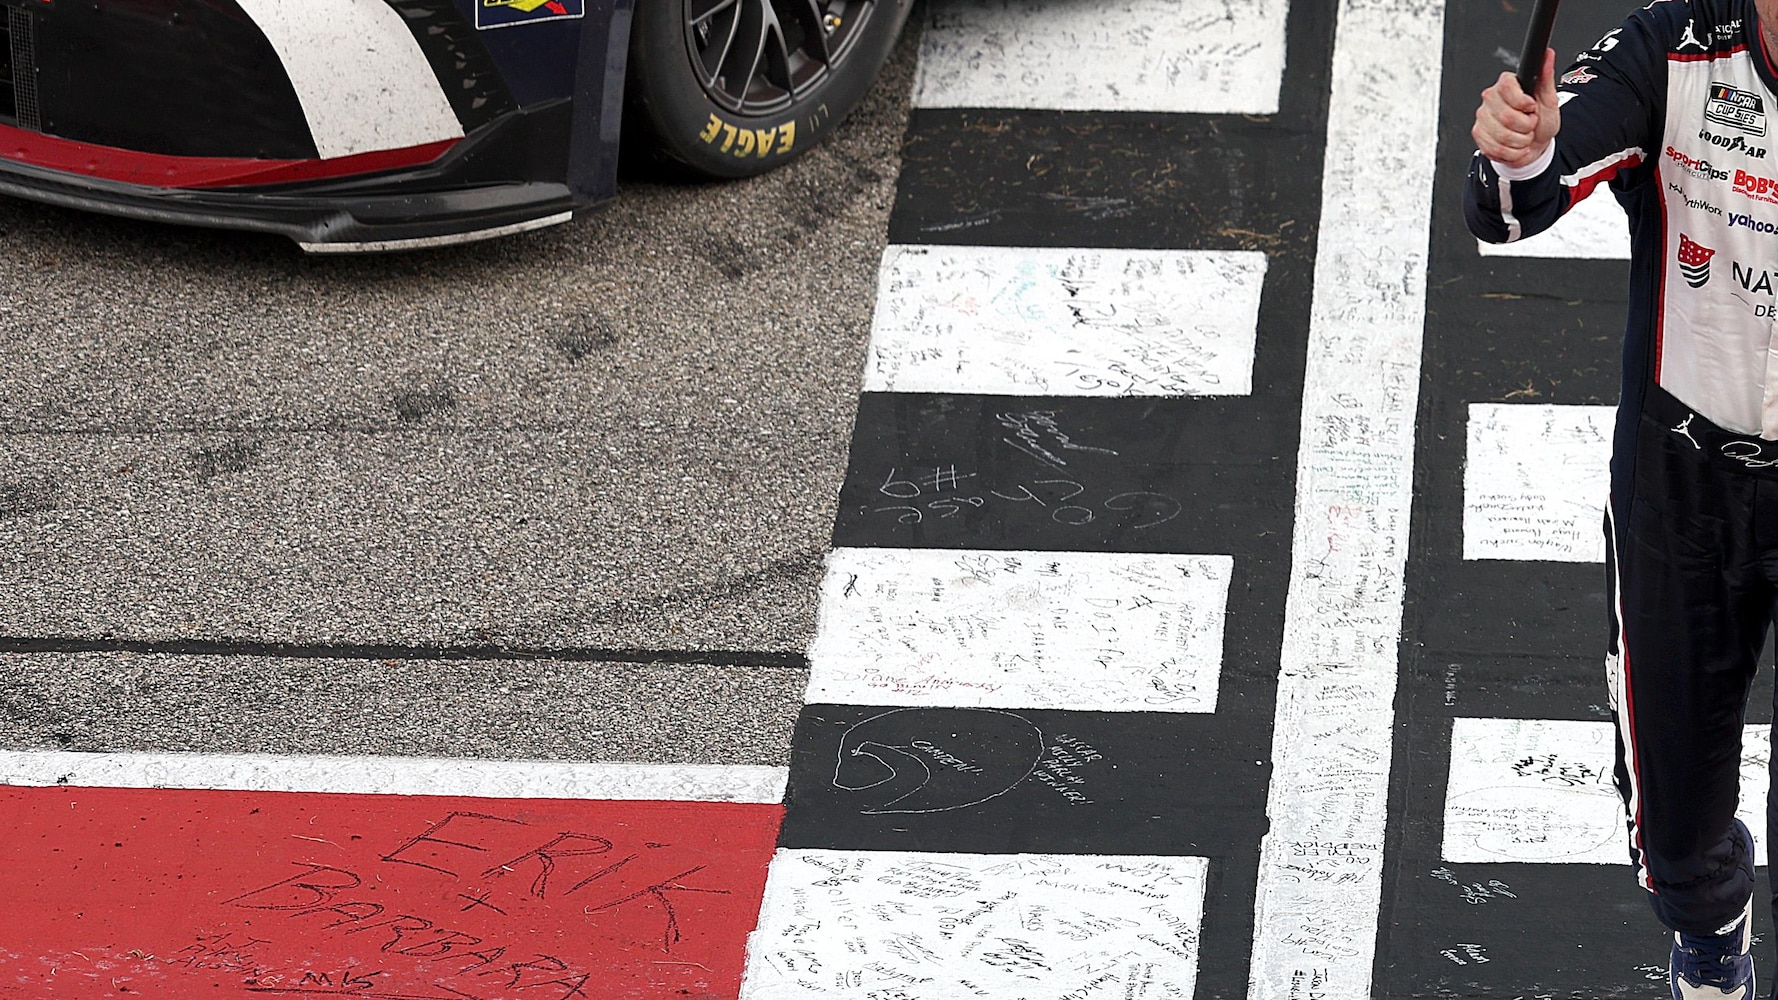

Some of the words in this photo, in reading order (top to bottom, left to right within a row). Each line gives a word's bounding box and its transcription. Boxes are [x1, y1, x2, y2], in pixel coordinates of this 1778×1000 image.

[1715, 103, 1735, 118] CUP
[700, 112, 797, 159] EAGLE
[378, 811, 732, 954] ERIK
